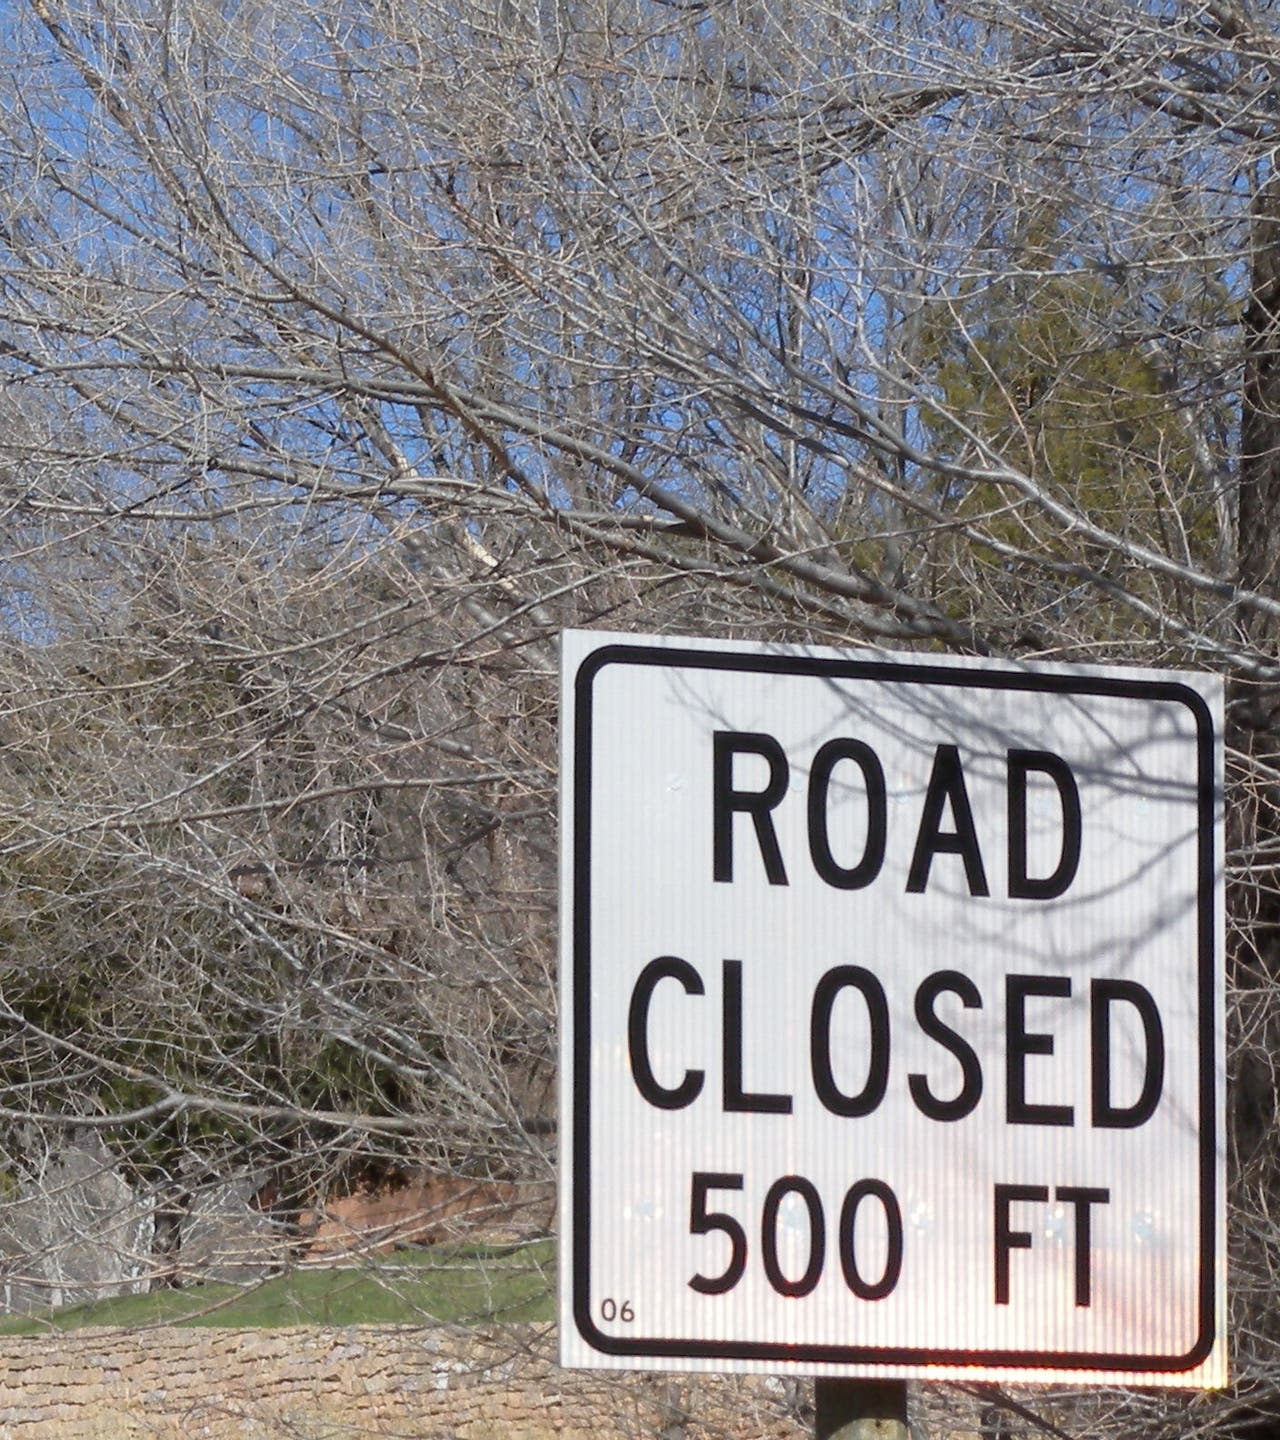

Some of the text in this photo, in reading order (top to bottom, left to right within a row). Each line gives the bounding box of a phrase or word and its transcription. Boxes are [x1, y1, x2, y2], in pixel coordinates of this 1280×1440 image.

[712, 730, 1082, 900] ROAD
[627, 955, 1165, 1129] CLOSED
[601, 1298, 635, 1322] 06
[688, 1172, 1110, 1308] 500 FT
